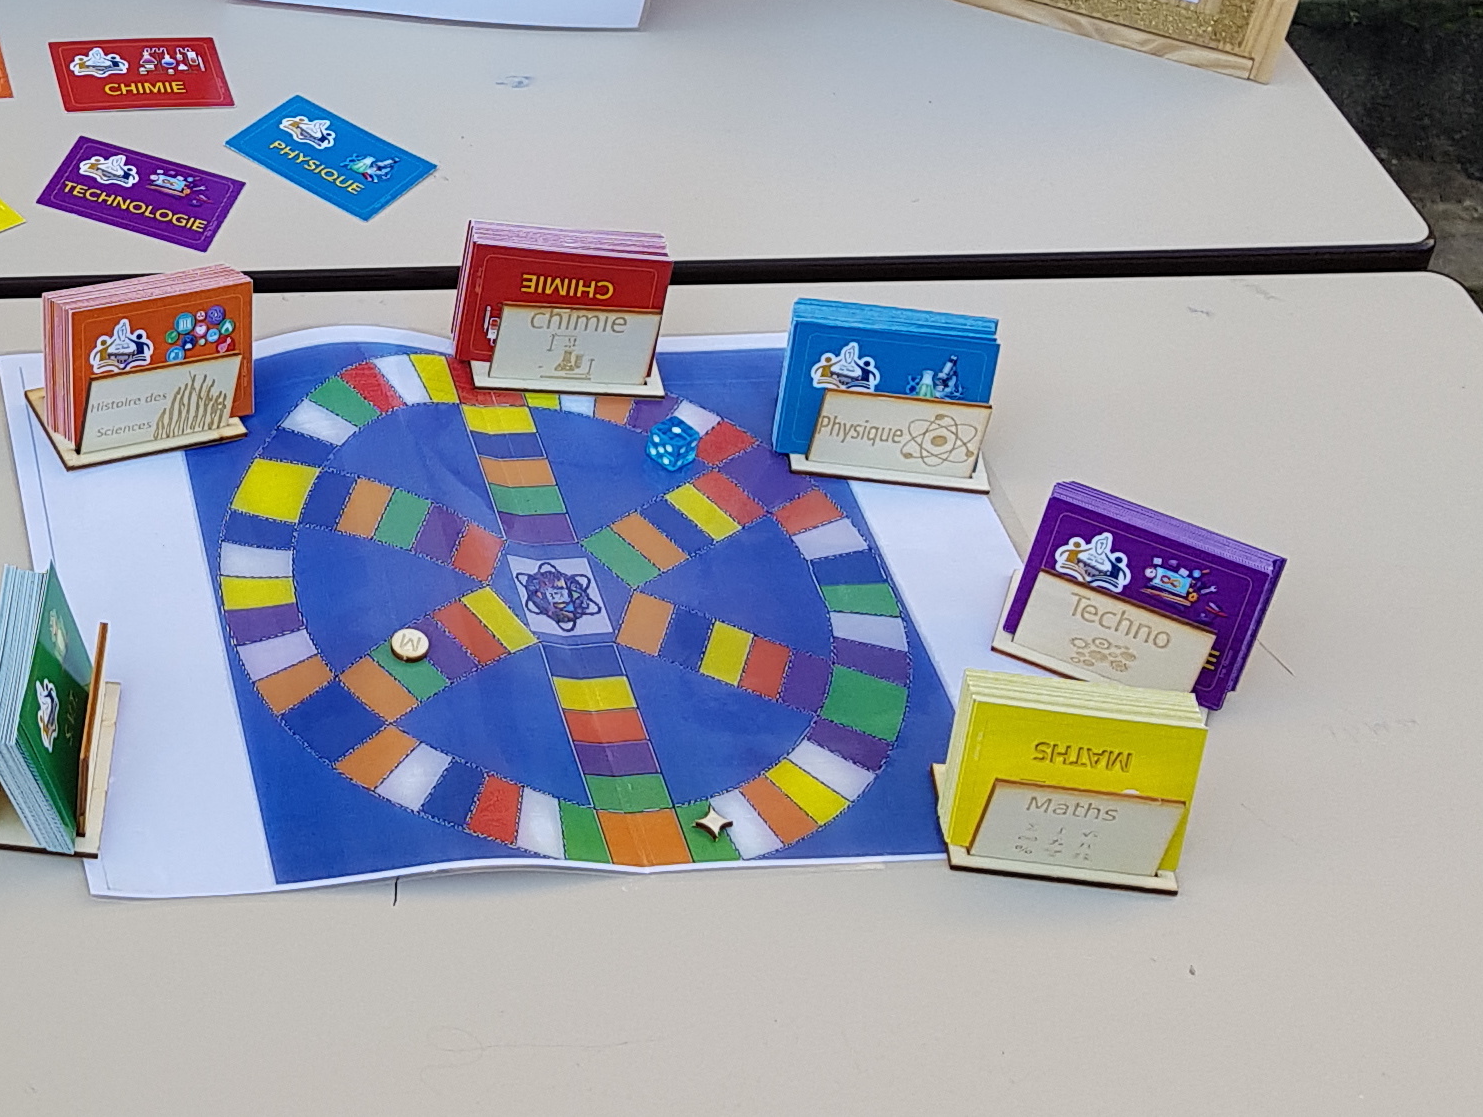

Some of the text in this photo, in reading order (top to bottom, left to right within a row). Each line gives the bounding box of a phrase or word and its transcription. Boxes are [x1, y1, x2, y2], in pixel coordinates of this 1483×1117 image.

[104, 81, 187, 96] CHIMIE
[269, 140, 366, 196] PHYSIQUE
[63, 180, 209, 233] TECHNOLOGIE
[520, 273, 614, 300] CHIMIE
[91, 392, 168, 413] Histoire des
[96, 420, 153, 438] Sciences
[817, 413, 904, 447] Physique
[1070, 591, 1172, 650] Techno
[1032, 741, 1134, 773] MATHS
[1025, 795, 1119, 822] Maths
